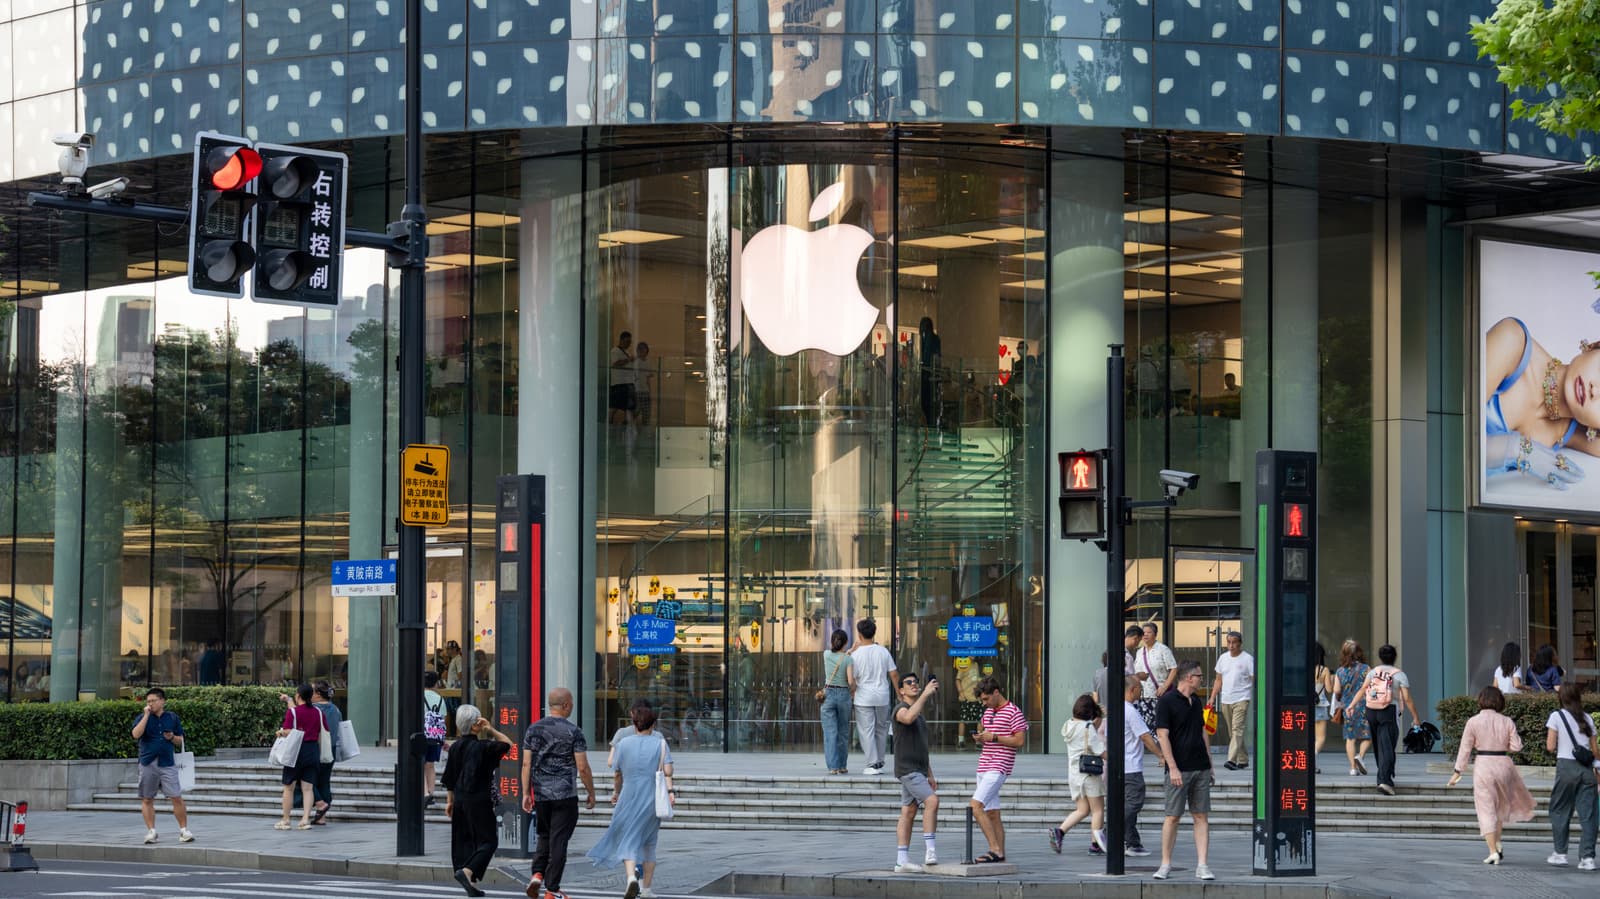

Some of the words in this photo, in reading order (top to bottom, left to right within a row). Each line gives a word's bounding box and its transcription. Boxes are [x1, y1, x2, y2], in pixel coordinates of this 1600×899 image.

[309, 170, 333, 290] 右转控制
[346, 565, 383, 580] 黄陂南路
[651, 619, 669, 629] Mac
[973, 621, 991, 631] iPad
[499, 706, 520, 726] 遵守
[1281, 709, 1308, 731] 遵守
[501, 743, 519, 761] 通
[1281, 749, 1308, 770] 交通
[499, 776, 520, 797] 信号
[1281, 787, 1309, 811] 信号
